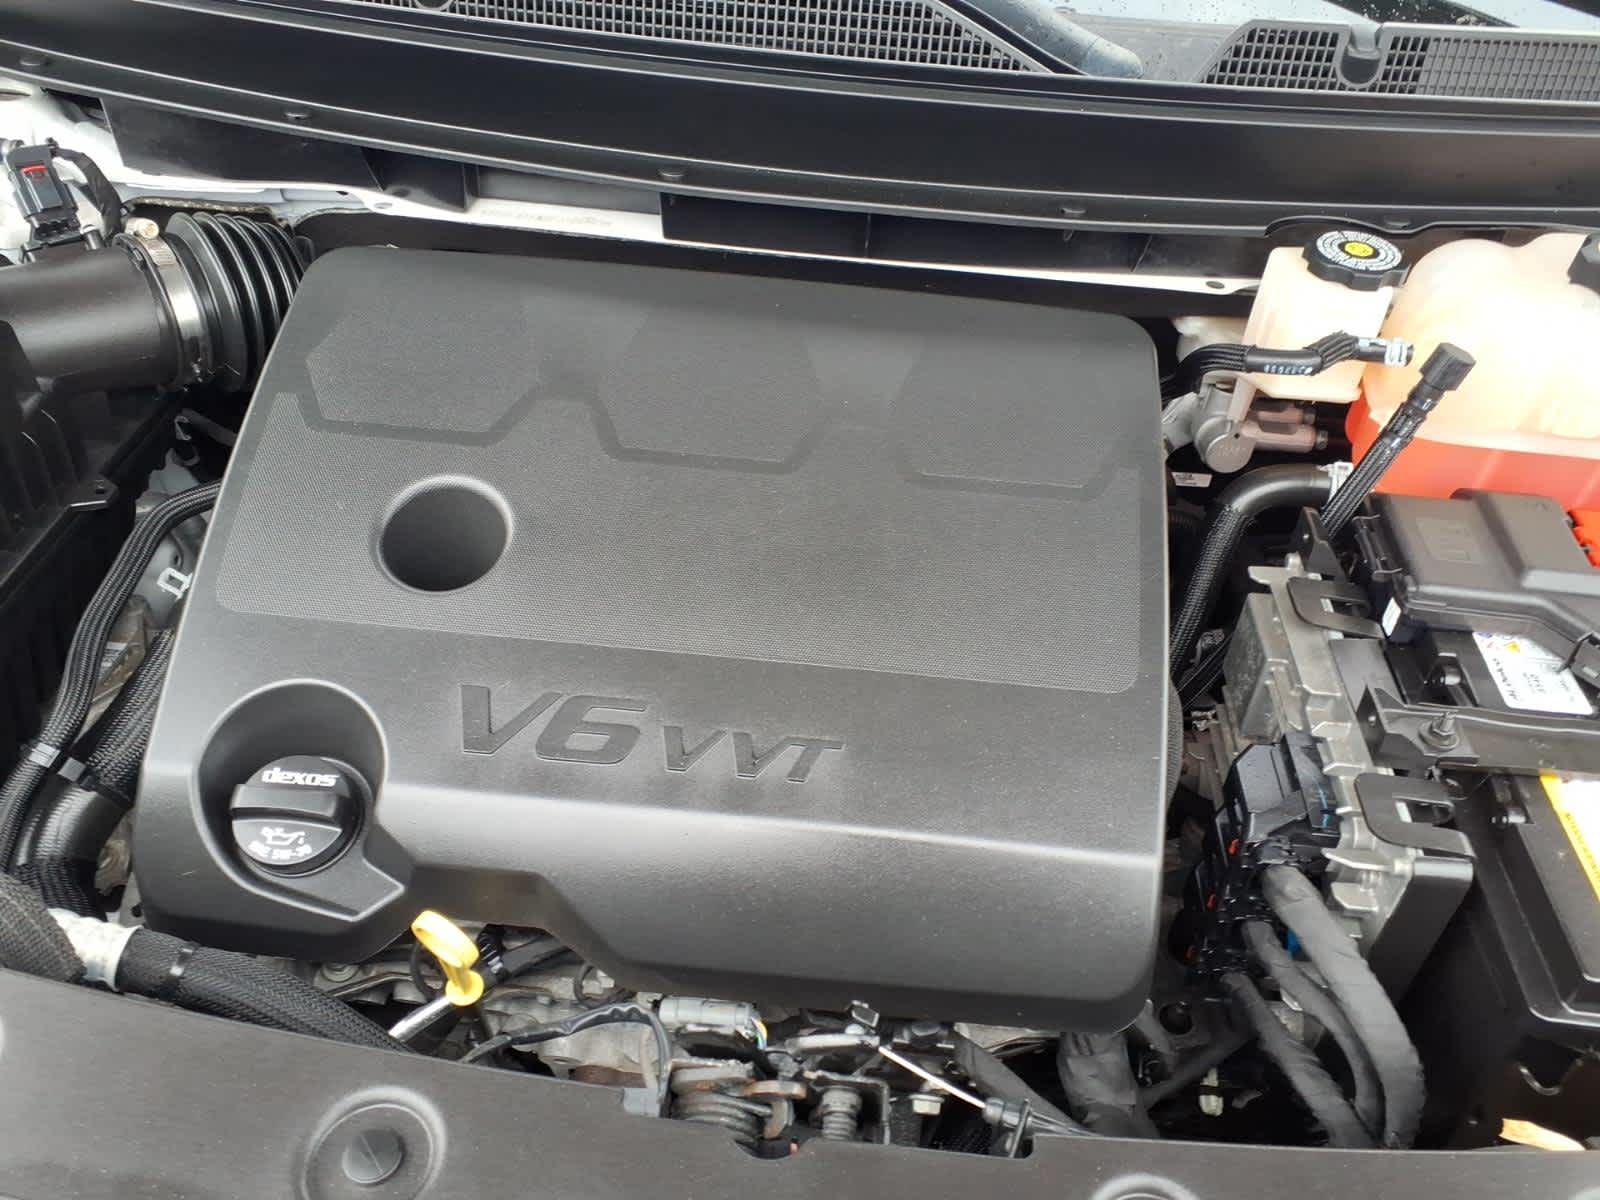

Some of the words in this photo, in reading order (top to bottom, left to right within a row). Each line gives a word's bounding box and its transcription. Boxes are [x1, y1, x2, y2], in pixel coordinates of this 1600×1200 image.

[460, 684, 647, 765] V6
[663, 724, 847, 783] VVT
[261, 767, 339, 788] dexos
